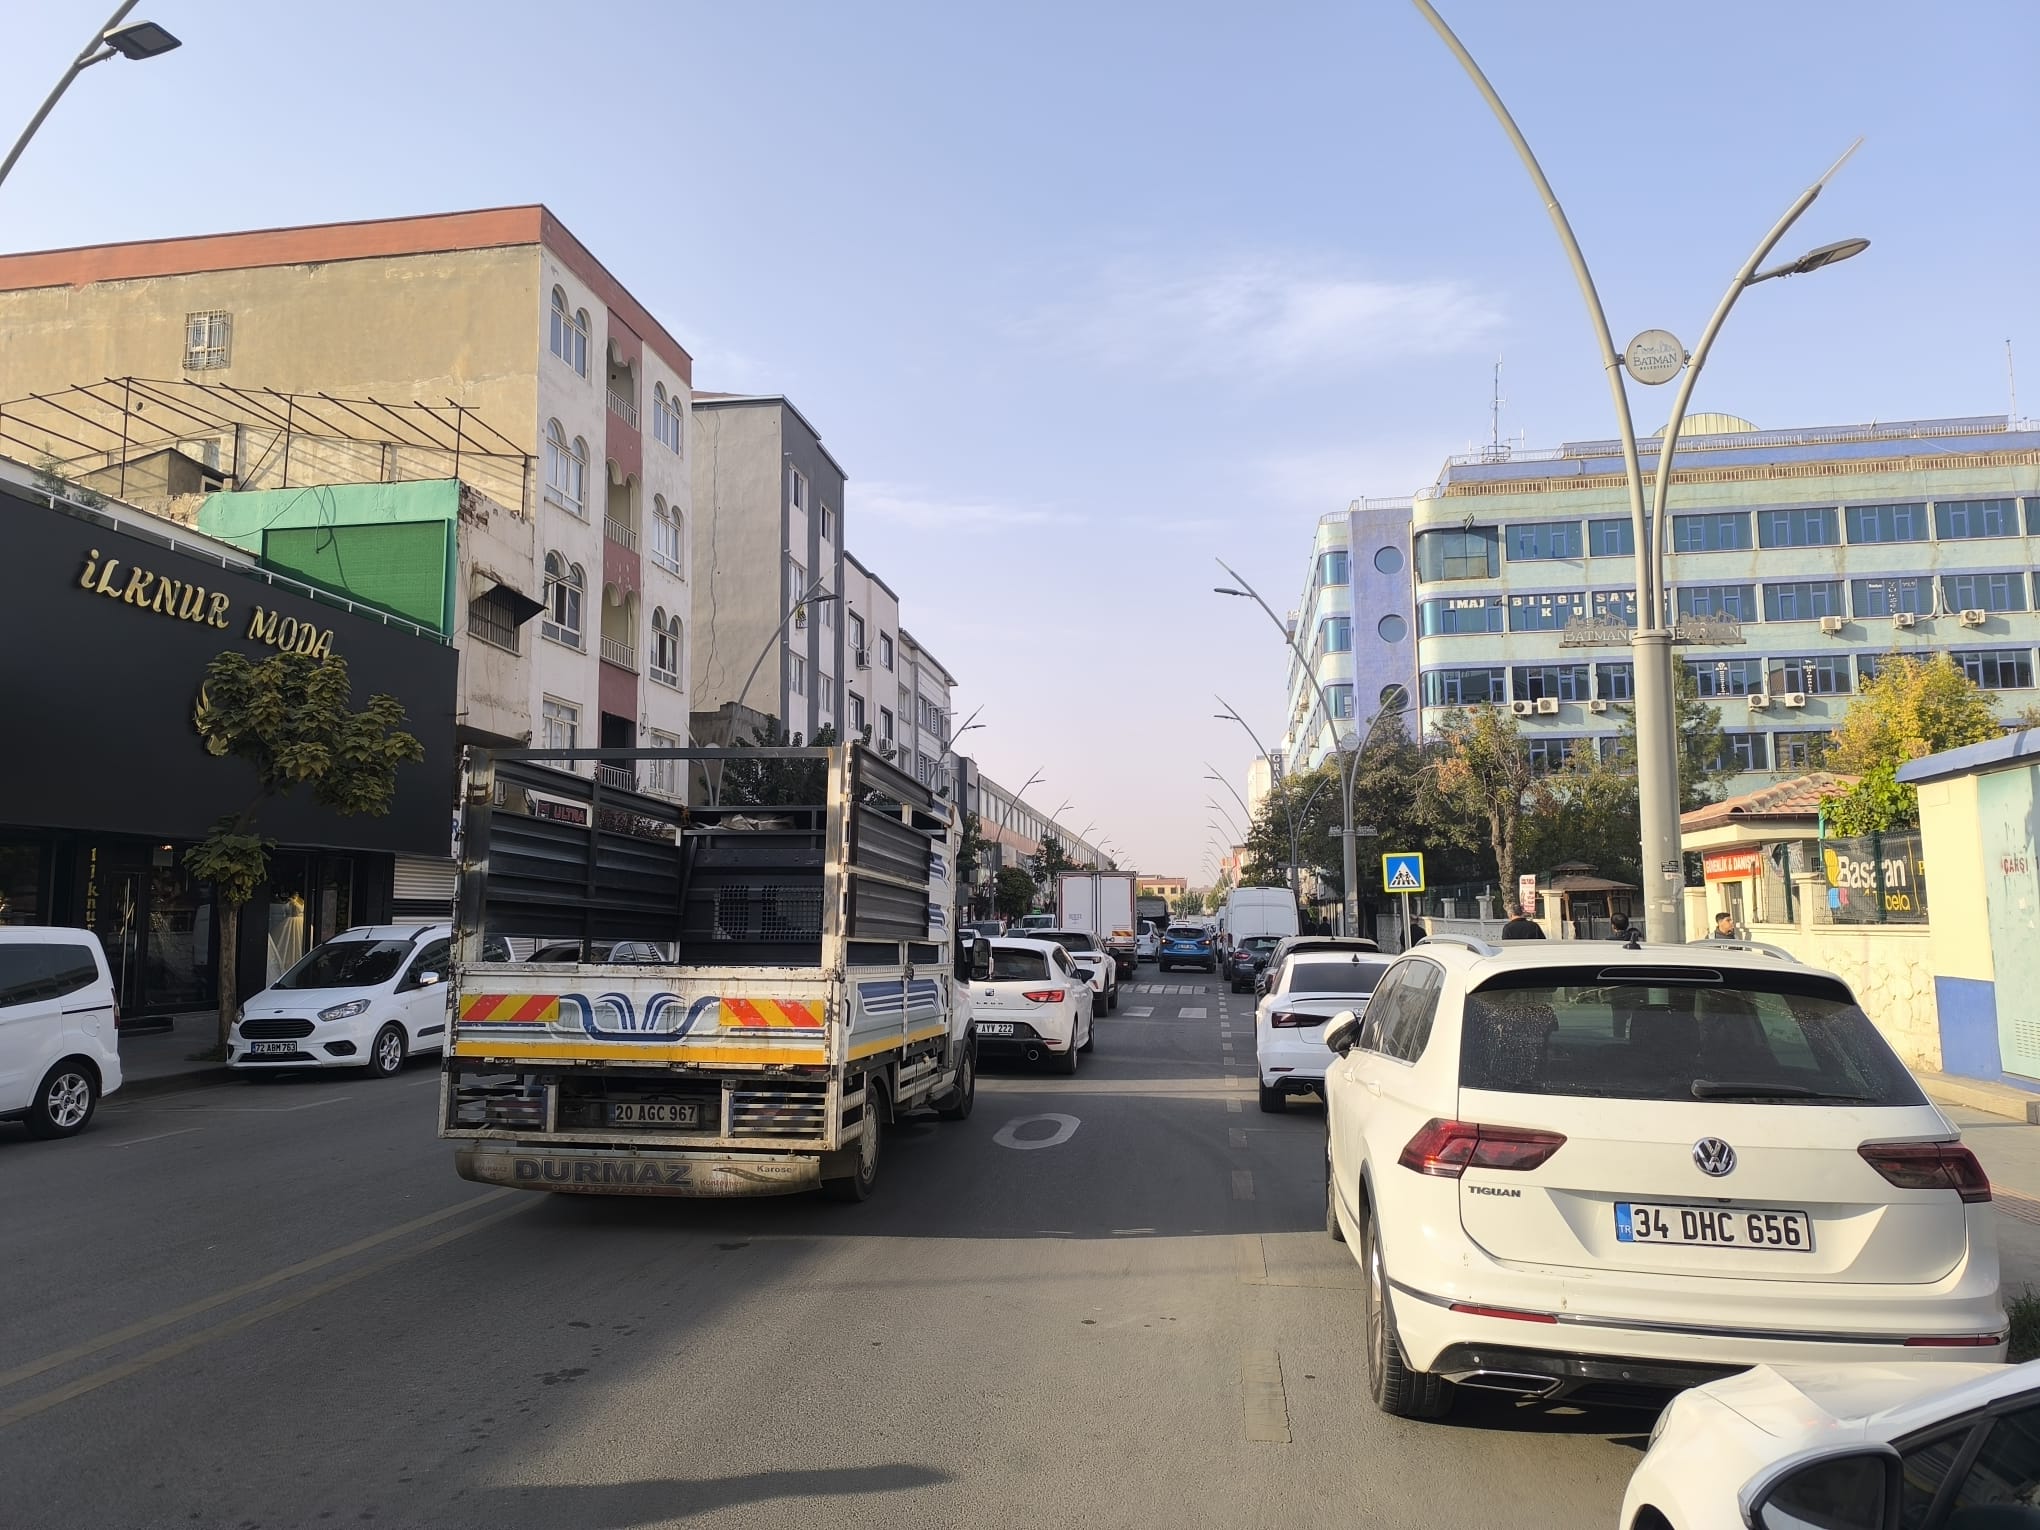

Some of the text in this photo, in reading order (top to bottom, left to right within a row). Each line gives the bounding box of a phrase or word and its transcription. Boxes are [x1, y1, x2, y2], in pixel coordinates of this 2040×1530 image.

[1633, 352, 1677, 367] BATMAN
[249, 605, 334, 659] MODA
[1565, 630, 1627, 641] BATMAN
[1872, 890, 1911, 911] Tbela
[998, 1024, 1013, 1033] 222
[255, 1043, 295, 1052] 72 ABM 763
[616, 1105, 696, 1121] 20 AGC 967
[513, 1158, 693, 1187] DURMAZ
[1468, 1186, 1521, 1198] TIGUAN
[1618, 1208, 1801, 1246] TR 34 DHC 656
